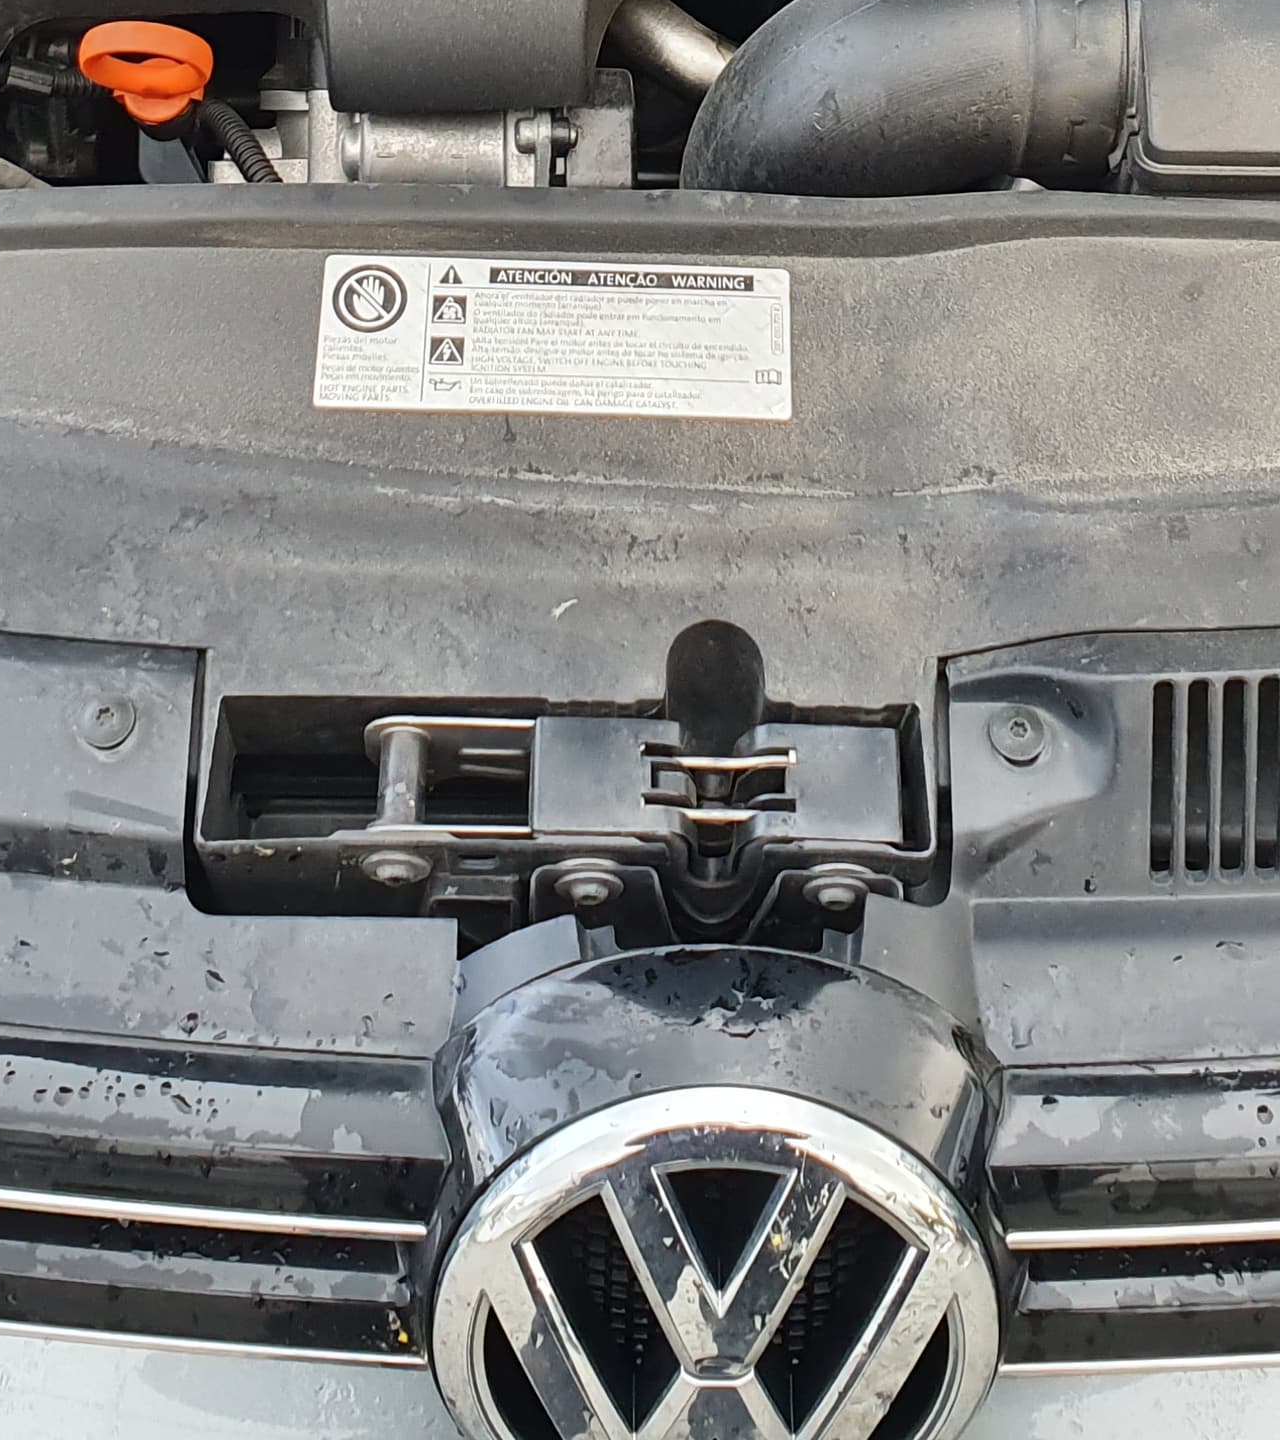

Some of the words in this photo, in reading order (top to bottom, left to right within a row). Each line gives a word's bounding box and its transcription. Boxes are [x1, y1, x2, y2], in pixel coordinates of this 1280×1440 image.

[497, 268, 572, 284] ATENCIÓN
[587, 272, 657, 289] ATENÇÃO
[671, 275, 744, 289] WARNING
[535, 327, 555, 335] MAY
[584, 328, 594, 336] AT
[370, 336, 399, 345] motor
